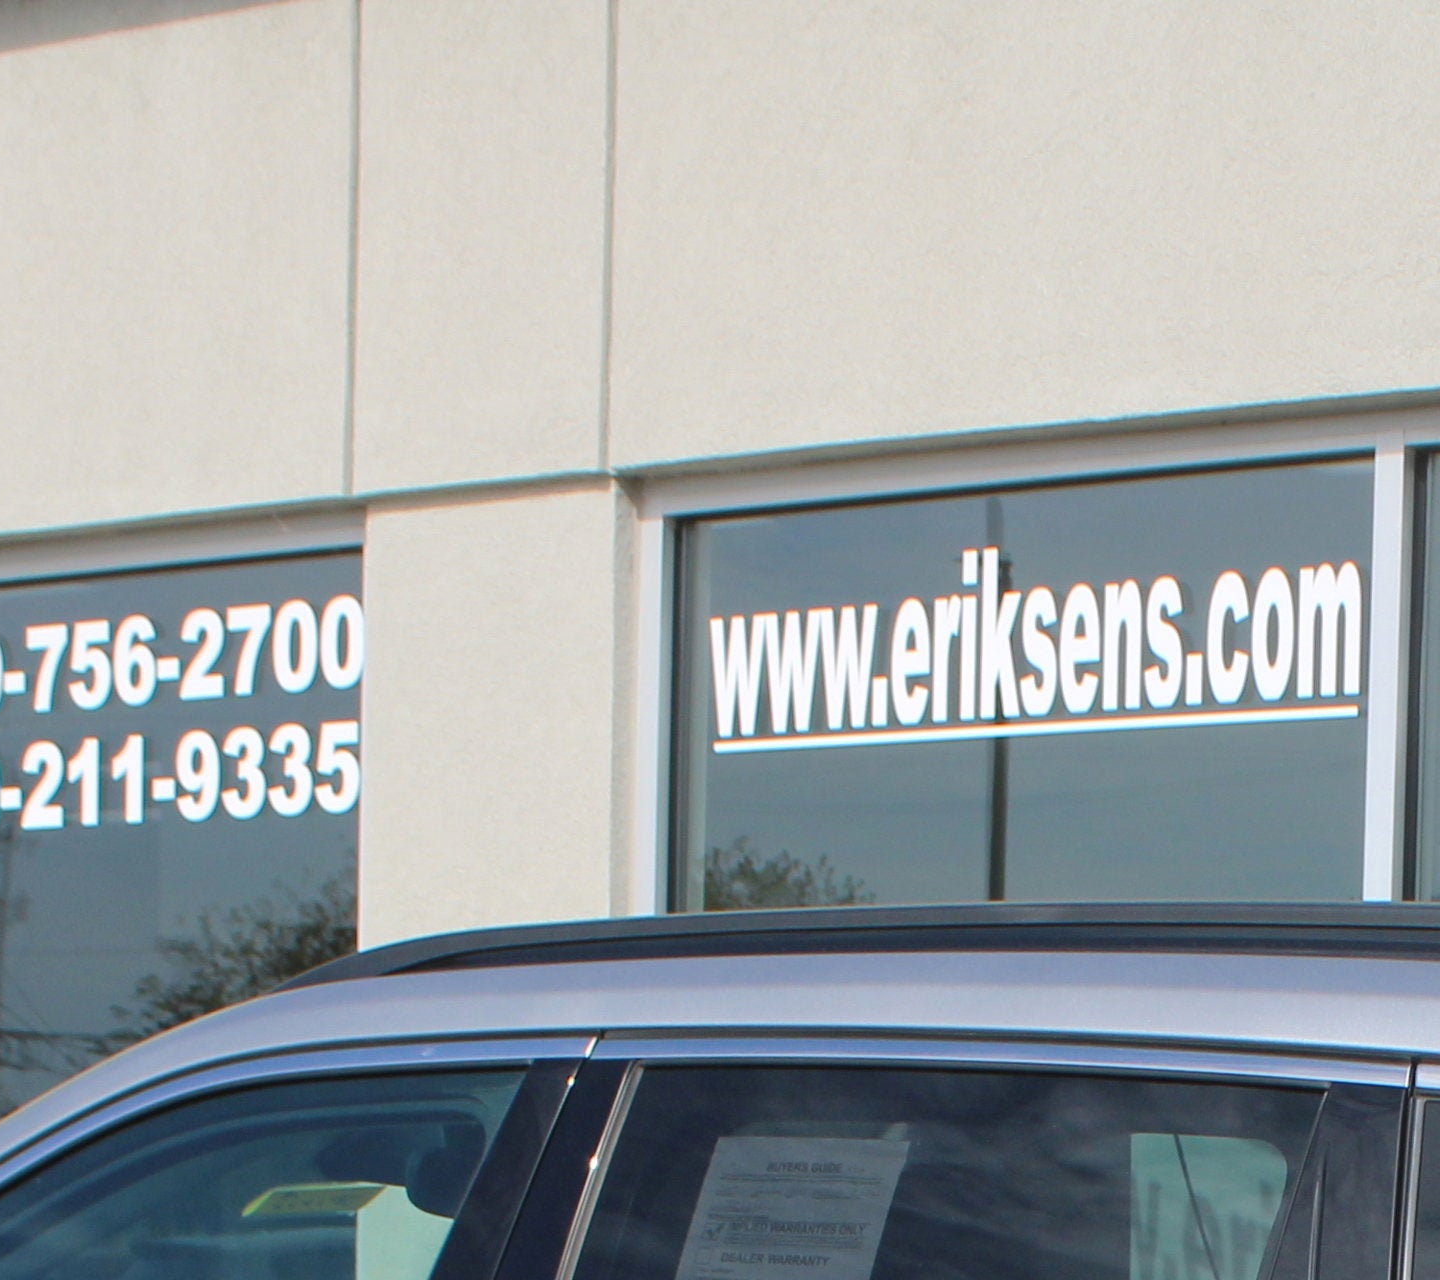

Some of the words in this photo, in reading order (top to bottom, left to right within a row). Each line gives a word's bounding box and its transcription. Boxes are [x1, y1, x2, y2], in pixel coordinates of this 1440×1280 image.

[708, 547, 1363, 738] www.eriksens.com
[811, 1162, 843, 1174] GUIDE
[720, 1252, 763, 1265] DEALER
[767, 1254, 831, 1267] WARRANTY
